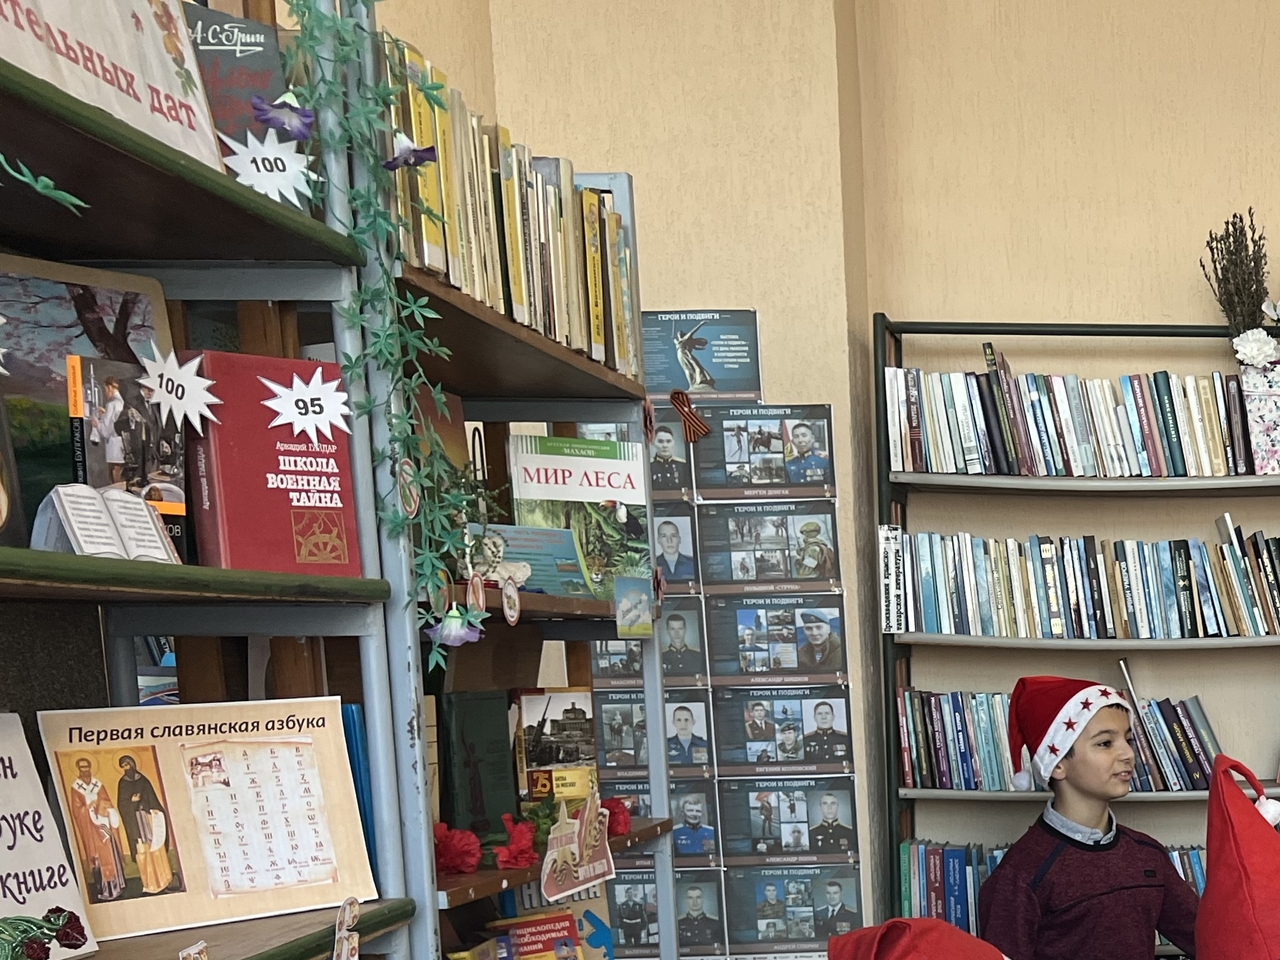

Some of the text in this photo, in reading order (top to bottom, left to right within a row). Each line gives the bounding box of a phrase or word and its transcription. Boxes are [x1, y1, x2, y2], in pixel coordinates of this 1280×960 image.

[147, 83, 196, 132] дат
[250, 156, 287, 173] 100
[687, 312, 720, 320] ПОДВИГИ
[156, 371, 186, 401] 100
[294, 397, 325, 417] 95
[758, 408, 791, 416] ПОДВИГИ
[277, 455, 340, 473] ШКОЛА
[266, 473, 341, 492] ВОЕННАЯ
[521, 466, 637, 491] МИР ЛЕСА
[288, 489, 344, 508] ТАЙНА
[764, 504, 796, 512] ПОДВИГИ
[1120, 561, 1131, 589] УМЕРОВ
[882, 547, 892, 633] Произведения крымско-
[893, 548, 903, 631] татарской литературы
[67, 713, 327, 745] Первая славянская азбука
[783, 780, 816, 788] ПОДВИГИ
[0, 808, 44, 851] уке
